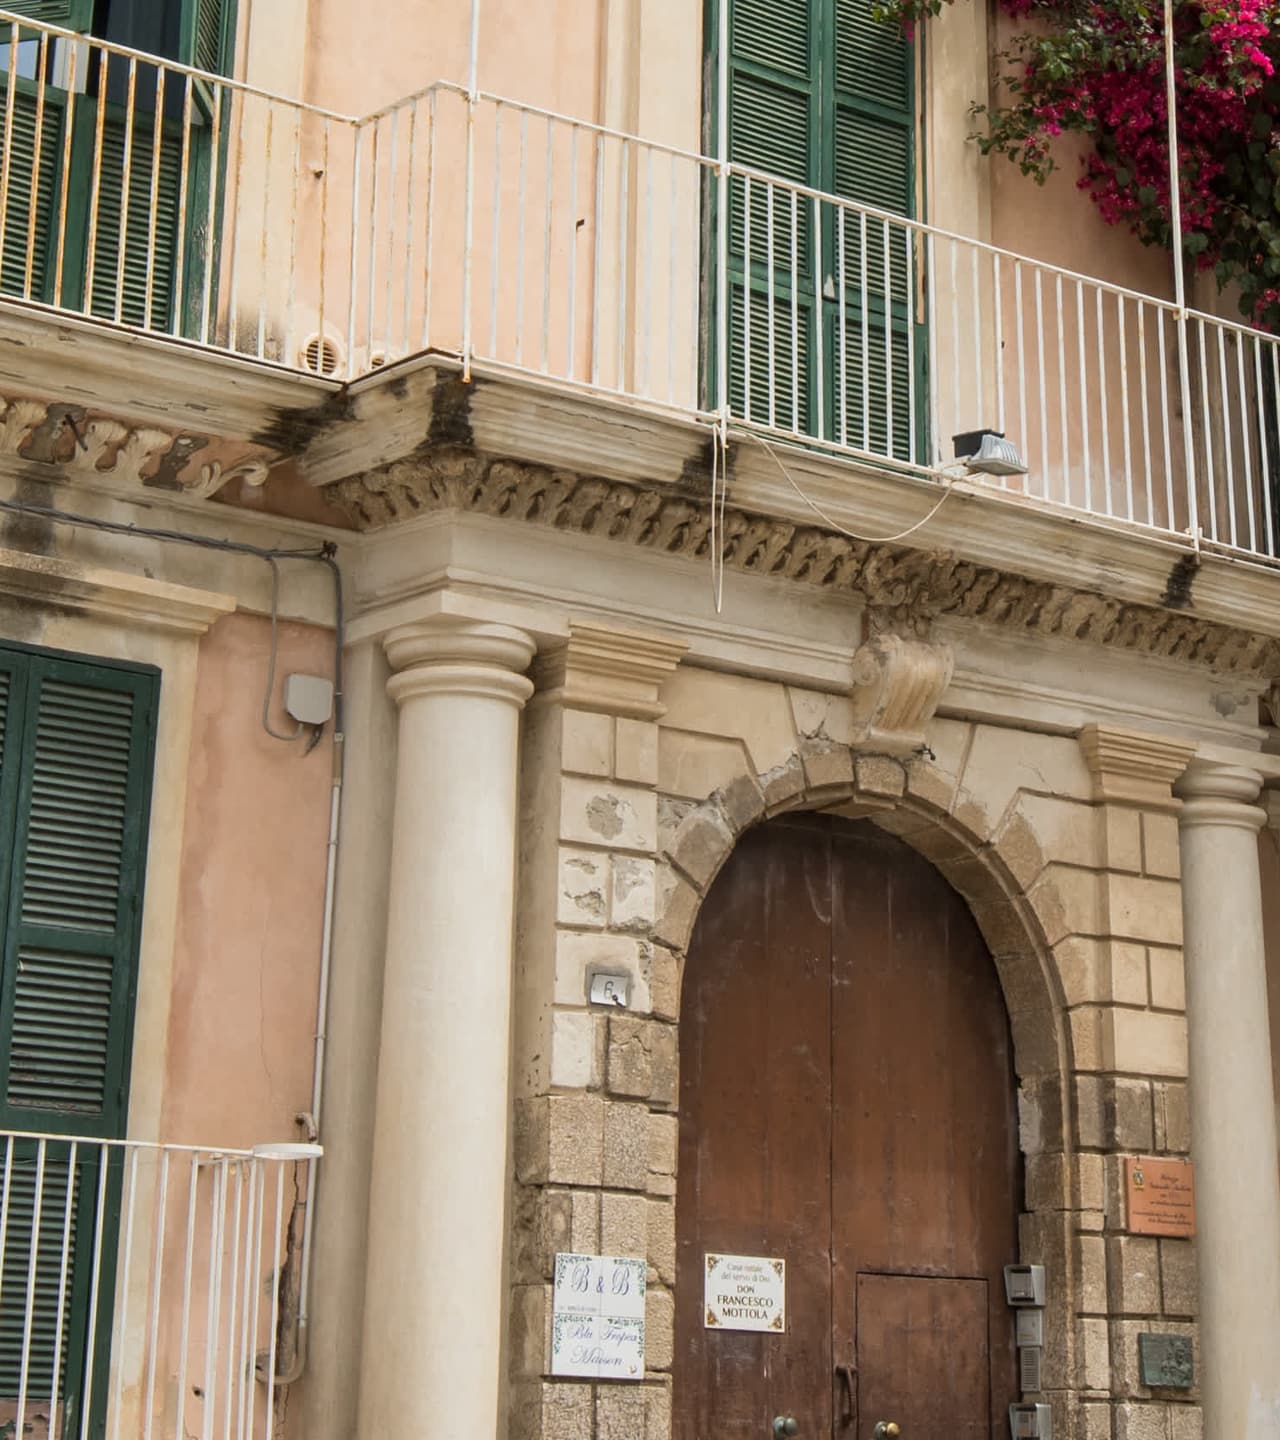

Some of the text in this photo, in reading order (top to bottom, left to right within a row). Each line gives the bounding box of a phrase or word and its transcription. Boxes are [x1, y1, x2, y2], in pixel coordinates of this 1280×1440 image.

[604, 980, 614, 1000] 6
[596, 1276, 605, 1293] &
[612, 1266, 630, 1296] B
[736, 1285, 755, 1294] DON
[717, 1294, 774, 1308] FRANCESCO
[722, 1308, 768, 1320] MOTTOLA
